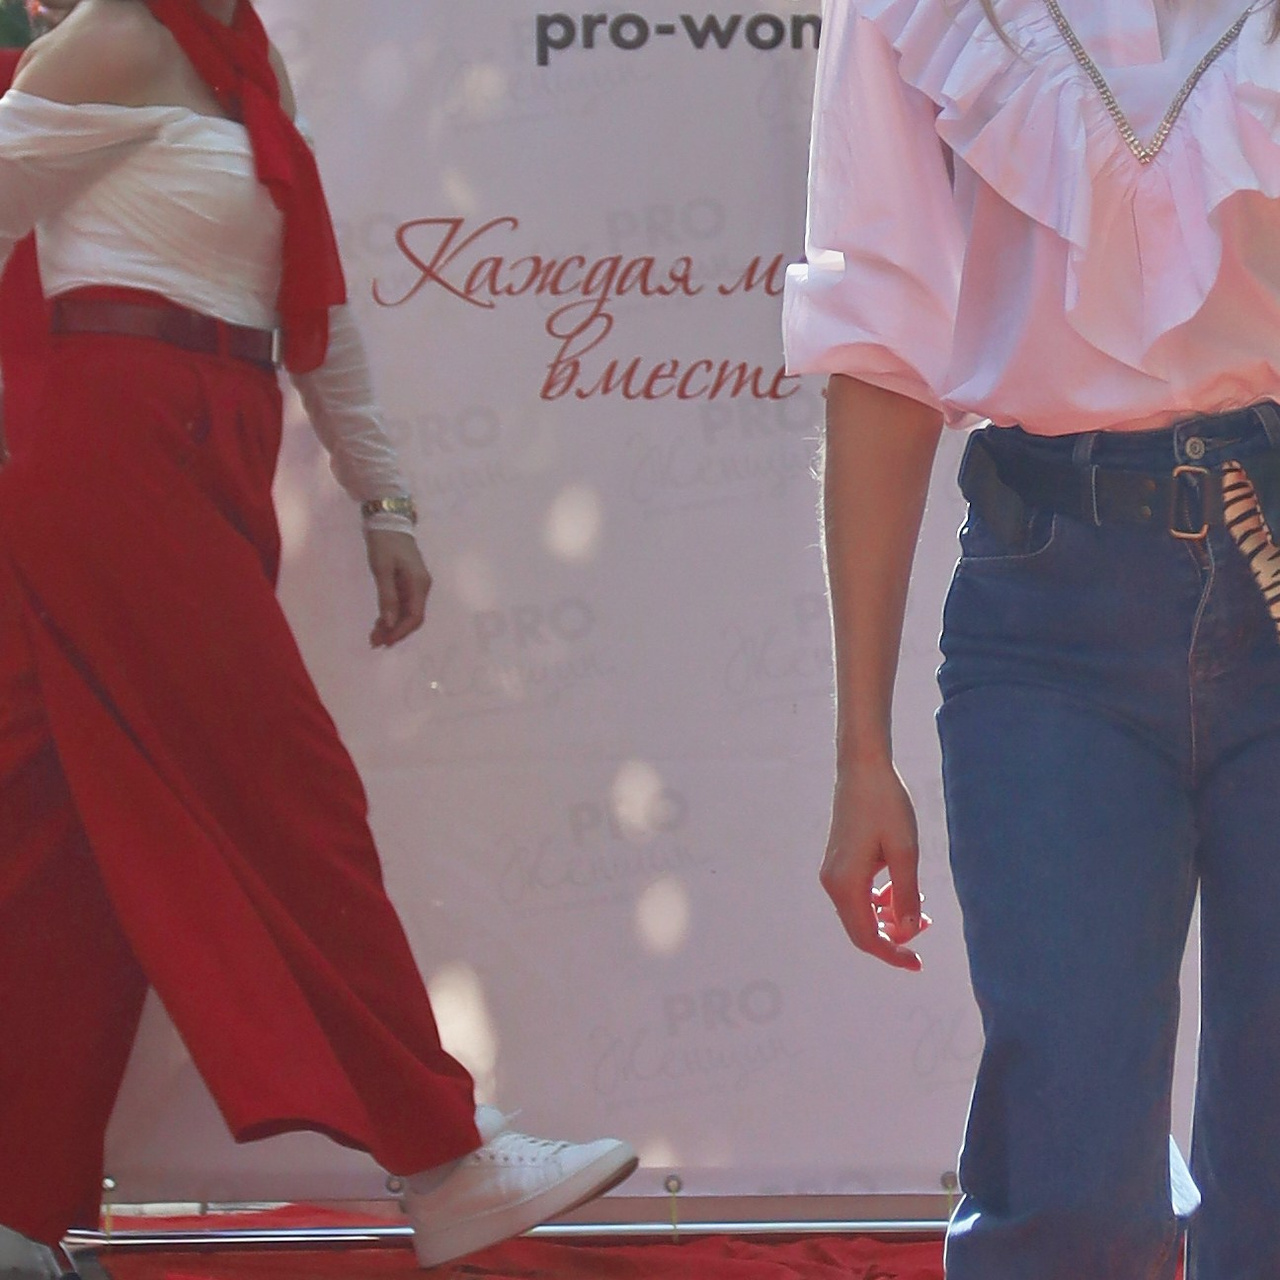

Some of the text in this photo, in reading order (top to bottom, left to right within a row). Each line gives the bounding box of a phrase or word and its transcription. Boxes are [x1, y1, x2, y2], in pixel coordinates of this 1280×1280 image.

[606, 196, 726, 252] PRO
[372, 216, 702, 308] Каждая
[717, 252, 786, 297] м
[539, 310, 803, 402] вместе
[472, 597, 596, 653] PRO
[662, 978, 784, 1037] PRO
